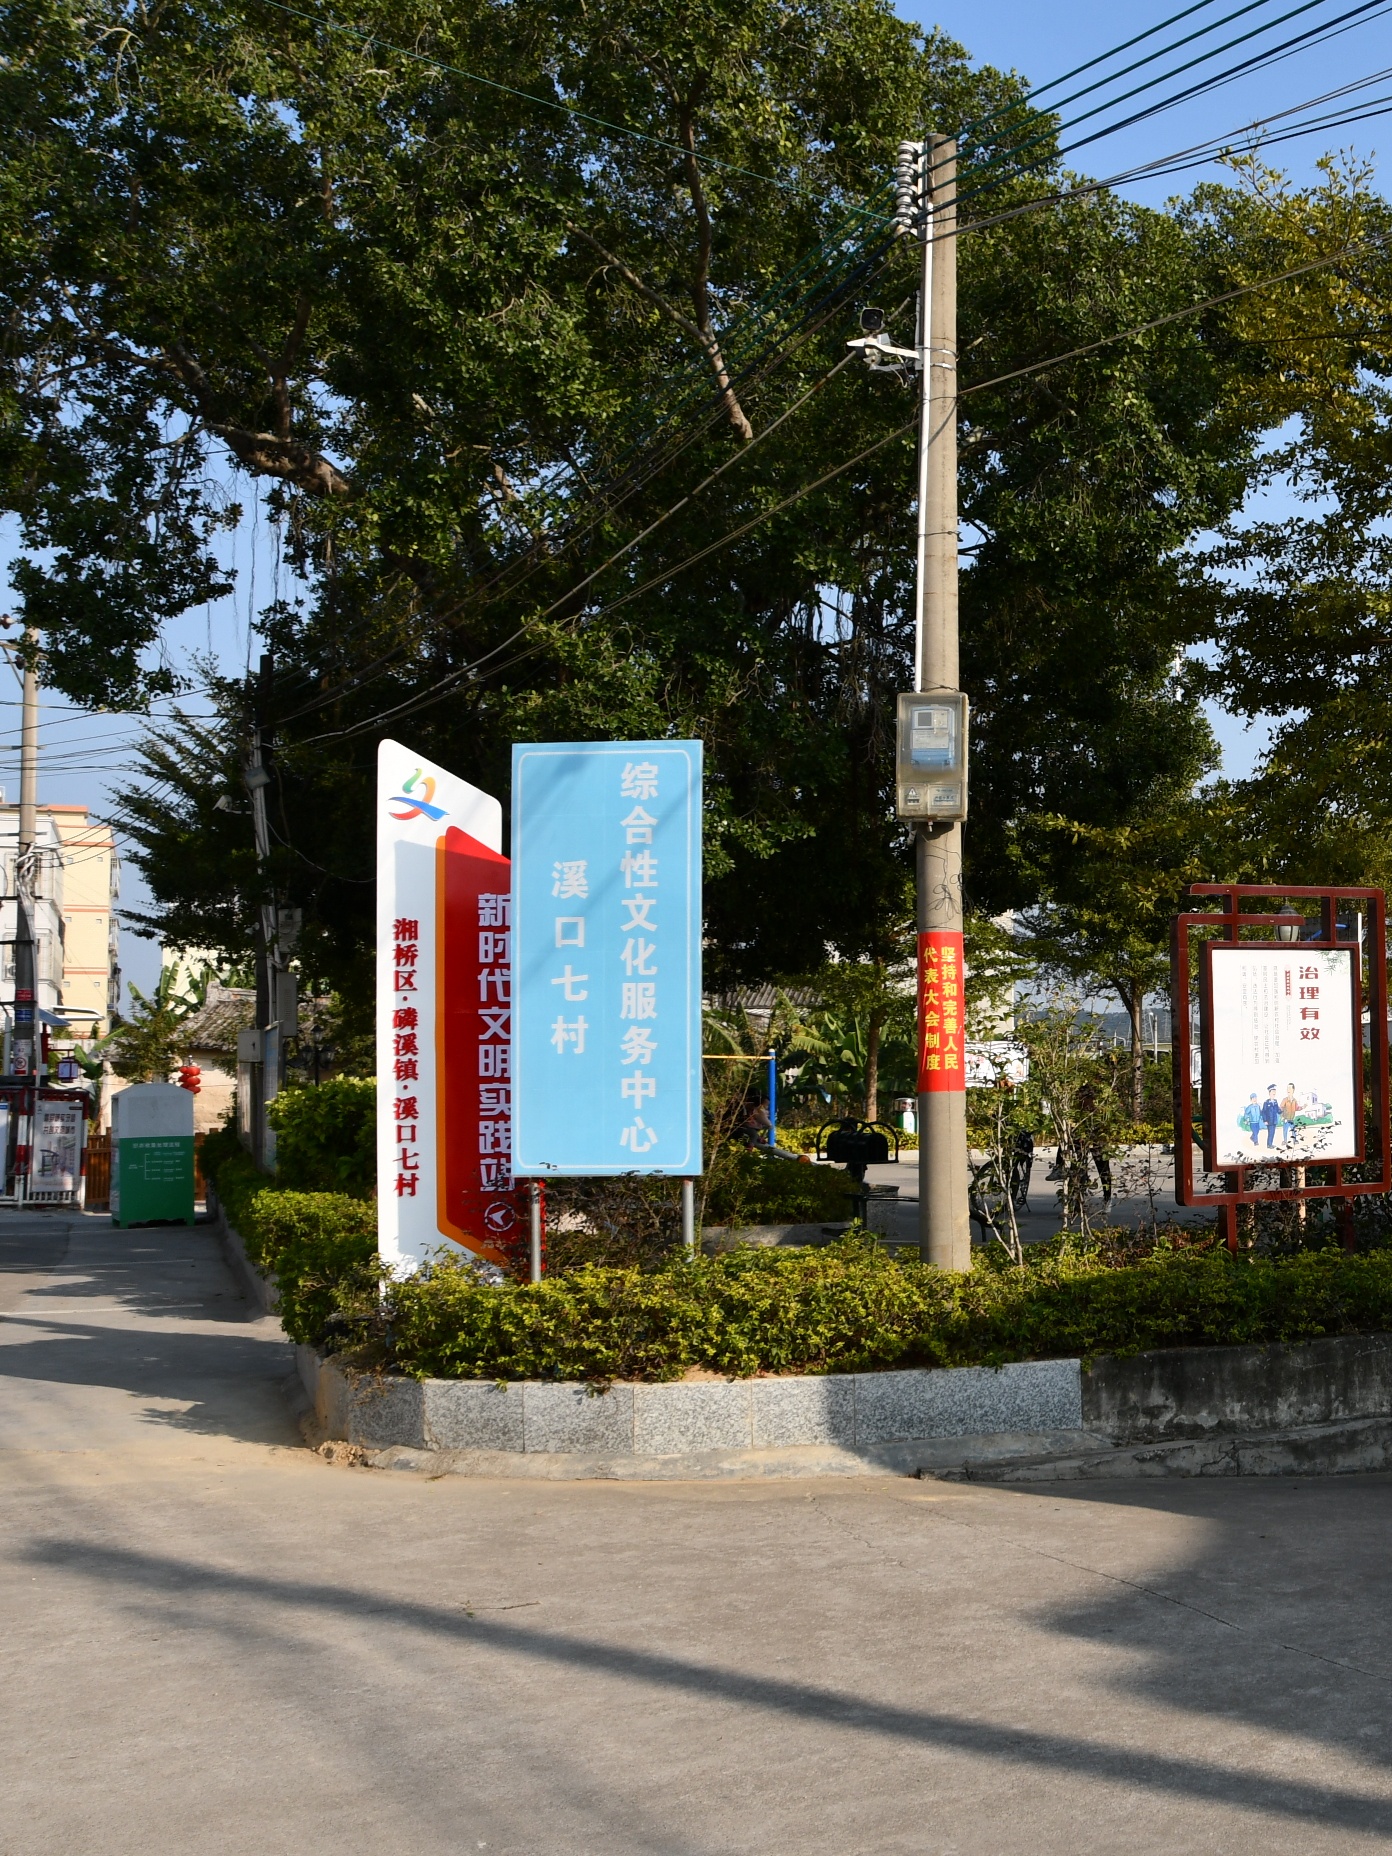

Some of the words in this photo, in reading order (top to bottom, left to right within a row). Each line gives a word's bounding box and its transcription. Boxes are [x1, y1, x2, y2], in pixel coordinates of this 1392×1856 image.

[478, 893, 515, 1192] 新时代文明实践站
[551, 860, 589, 1054] 溪口七村
[620, 762, 659, 1153] 综合性文化服务中心
[924, 947, 941, 1071] 代表大会制度
[941, 946, 959, 1070] 坚持和完善人民
[1299, 966, 1320, 1041] 治理有效
[392, 917, 420, 1197] 湘桥区·磷溪镇·溪口七村
